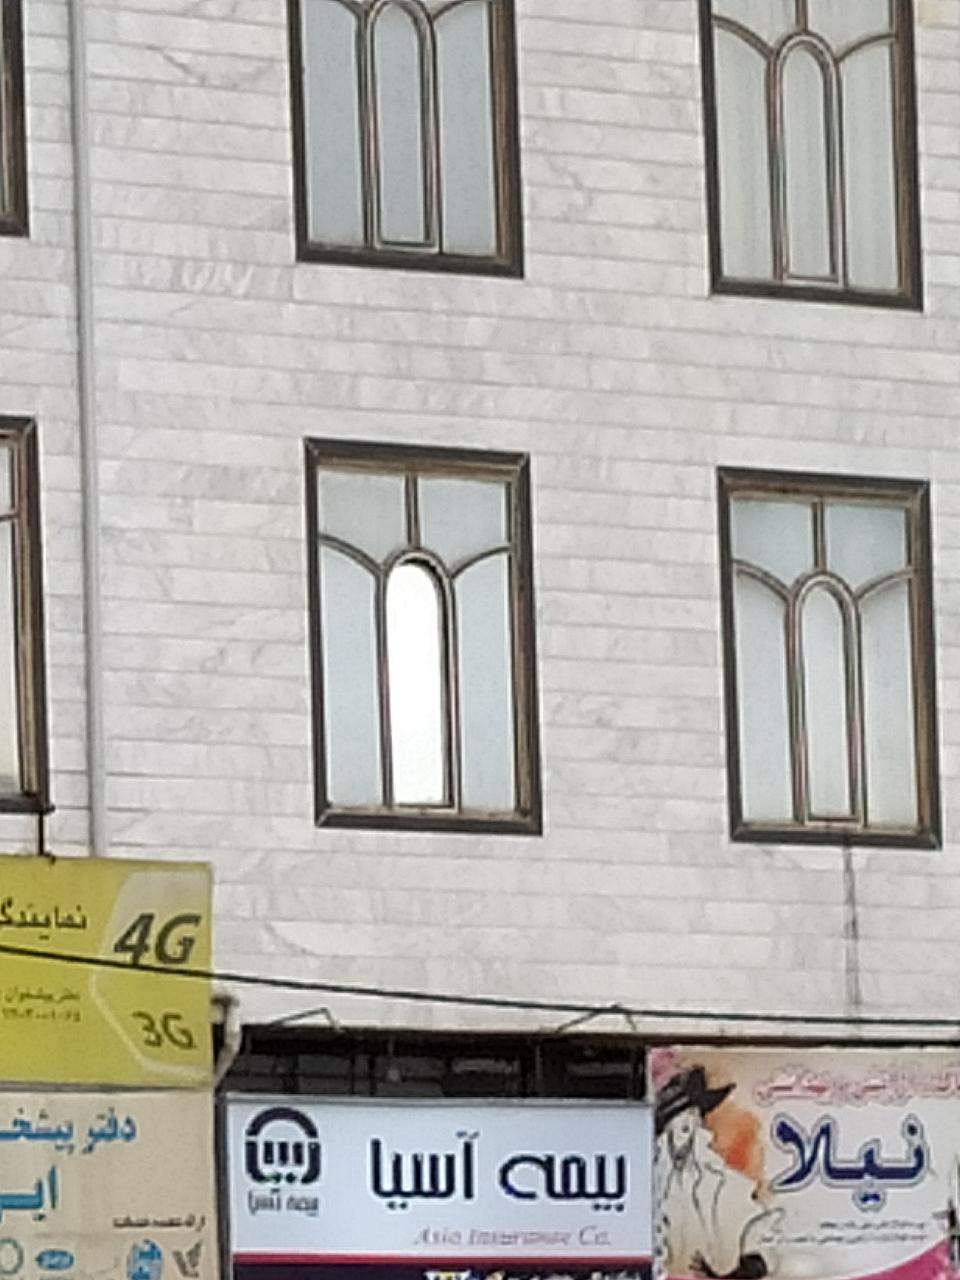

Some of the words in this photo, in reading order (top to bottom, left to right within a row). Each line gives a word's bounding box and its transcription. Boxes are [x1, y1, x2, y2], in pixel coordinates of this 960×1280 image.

[113, 912, 202, 965] 4G
[131, 1011, 197, 1049] 3G
[82, 1106, 137, 1155] دفتر
[370, 1130, 479, 1210] آسیا
[497, 1154, 627, 1212] بیمه
[774, 1118, 925, 1206] نیلا
[414, 1225, 463, 1246] Asia
